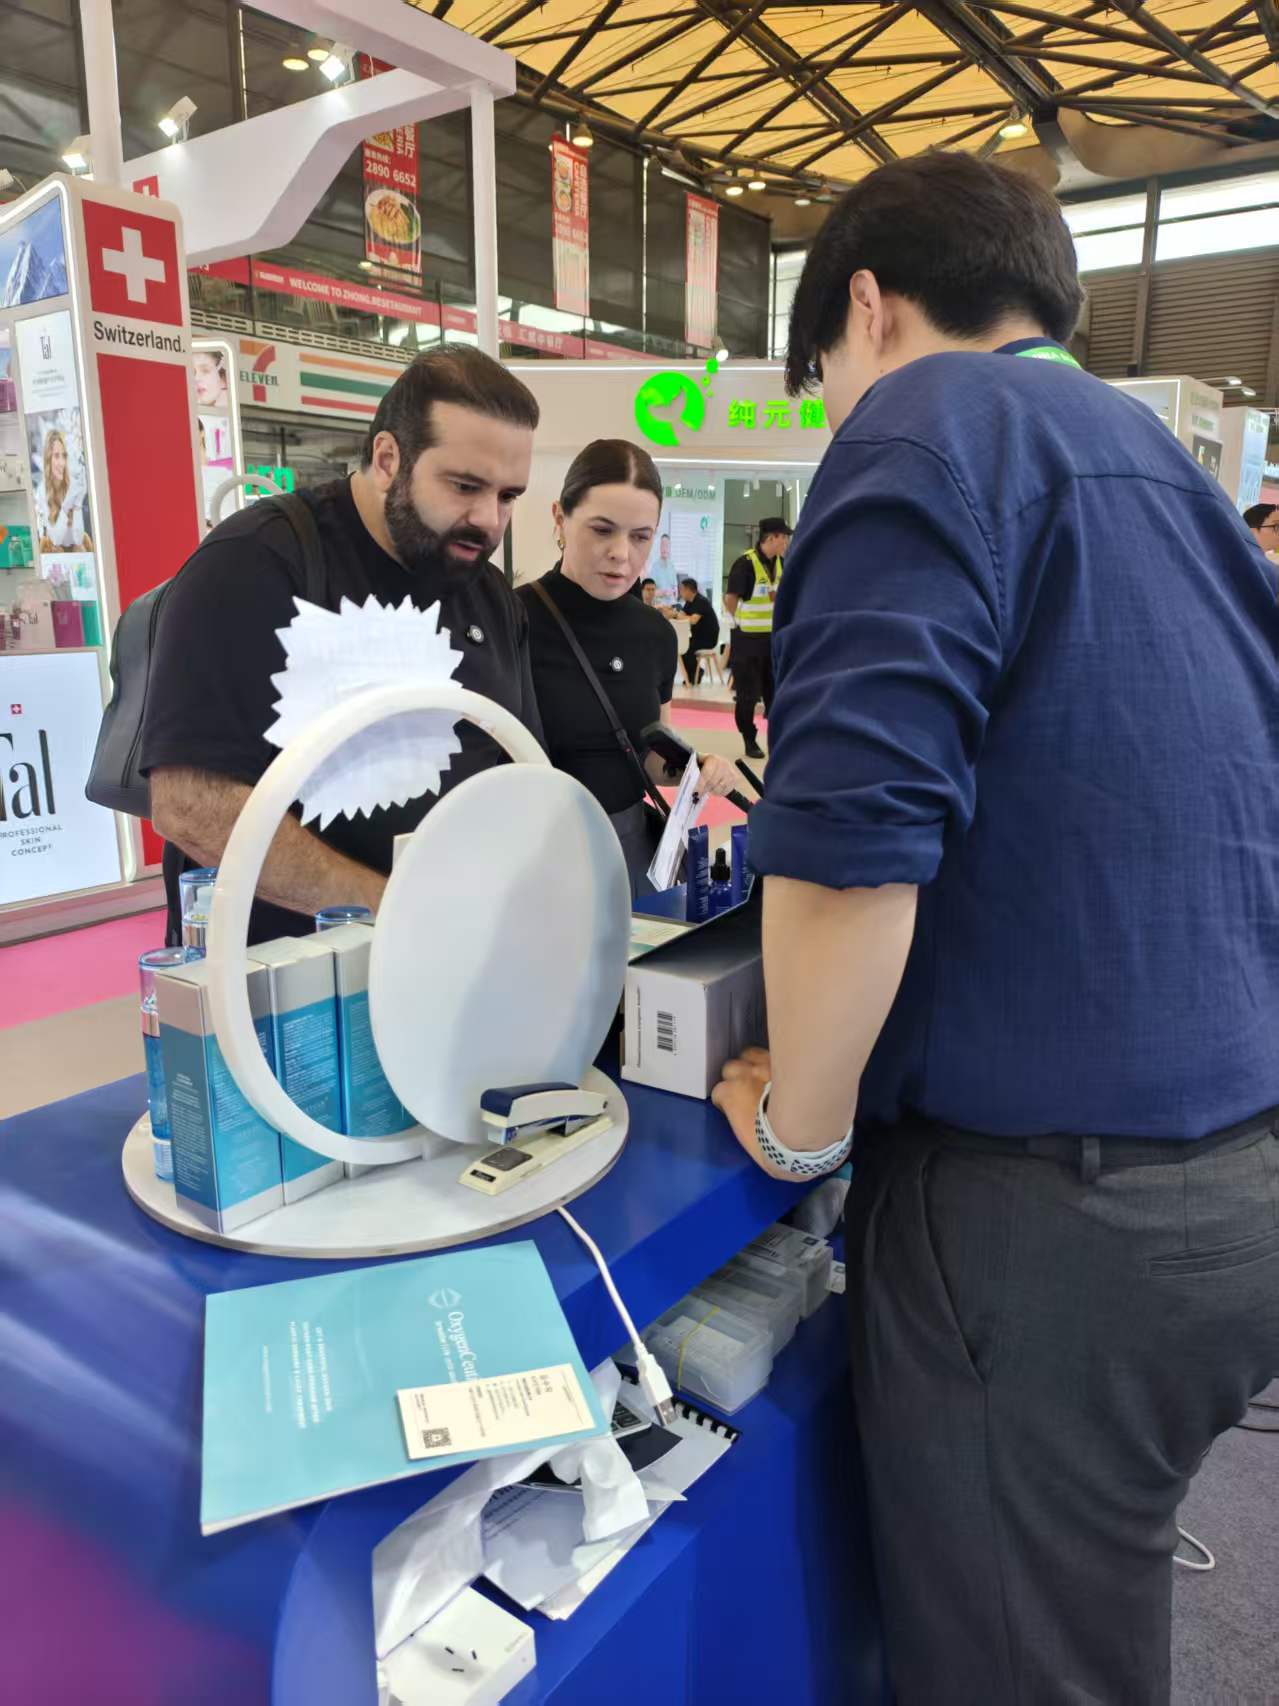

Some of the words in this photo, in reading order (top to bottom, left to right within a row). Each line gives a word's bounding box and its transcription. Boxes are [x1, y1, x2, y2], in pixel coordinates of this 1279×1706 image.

[366, 160, 390, 179] 2890
[289, 278, 329, 295] WELCOME
[94, 320, 185, 352] Switzerland.
[20, 837, 42, 846] SKIN
